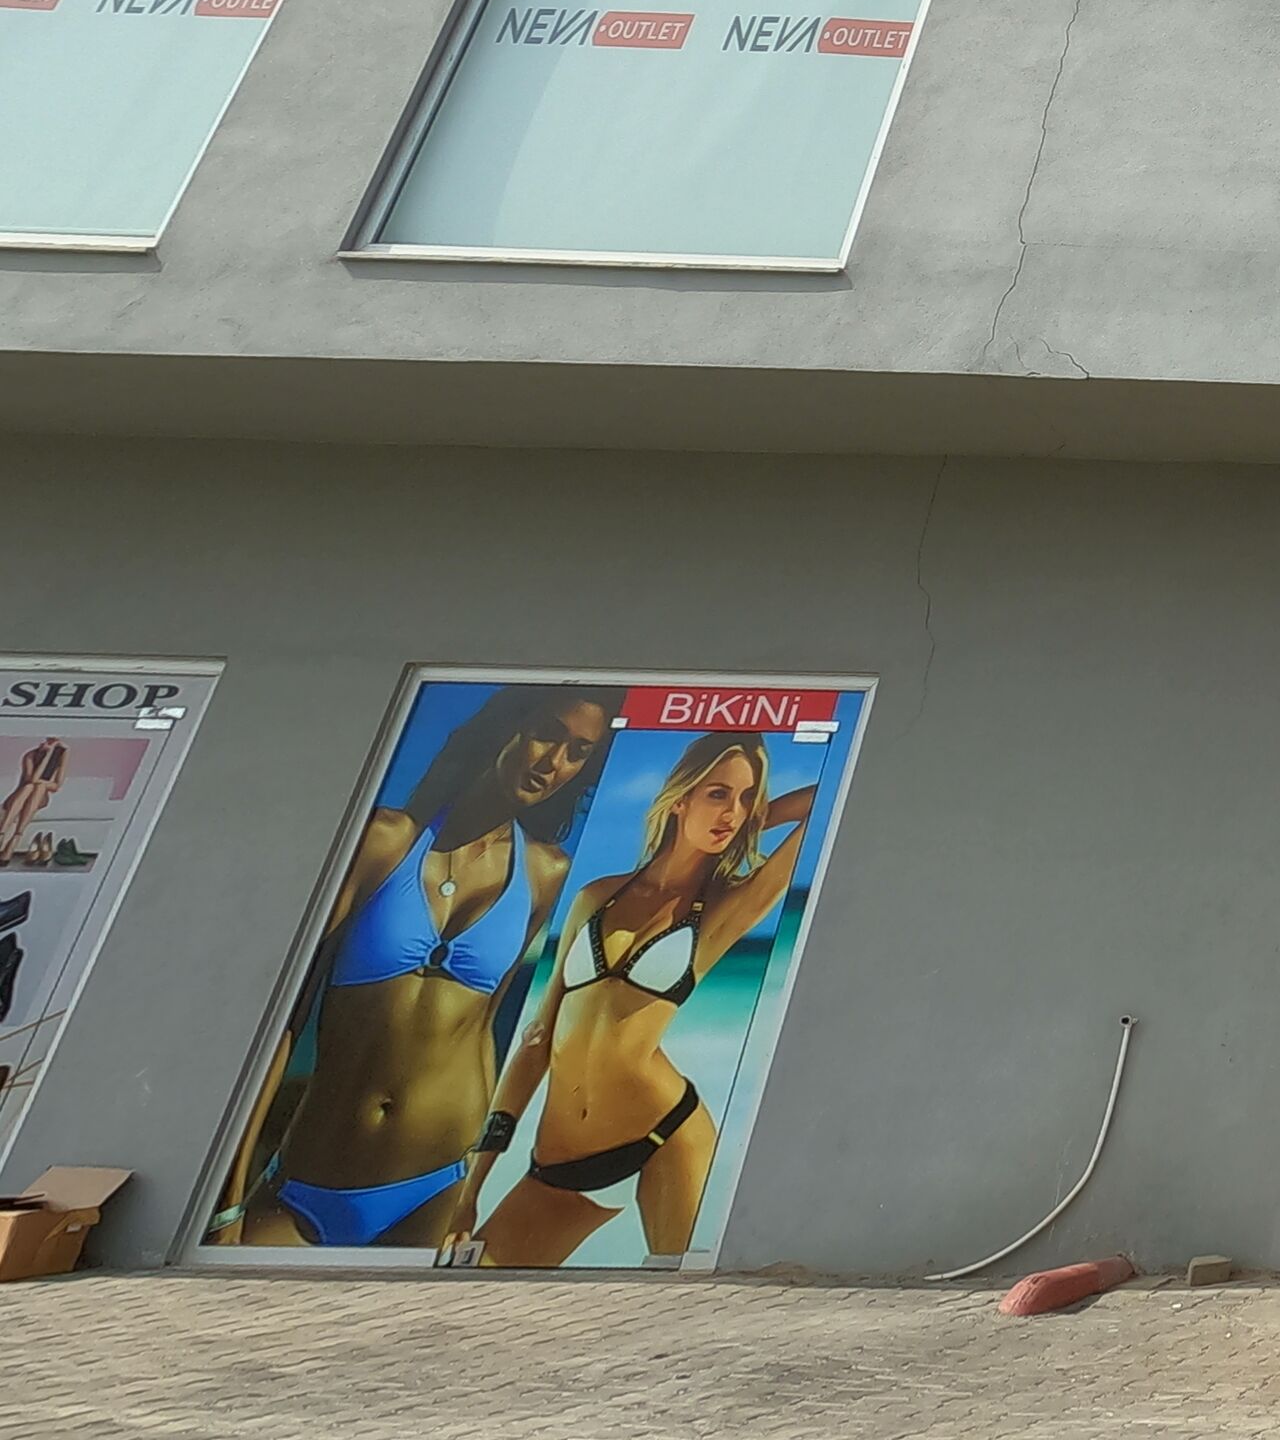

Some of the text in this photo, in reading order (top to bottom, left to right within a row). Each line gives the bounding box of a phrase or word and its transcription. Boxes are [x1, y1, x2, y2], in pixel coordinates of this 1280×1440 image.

[496, 7, 685, 46] NEVA OUTLET
[722, 15, 909, 53] NEVA OUTLET
[2, 681, 180, 709] SHOP
